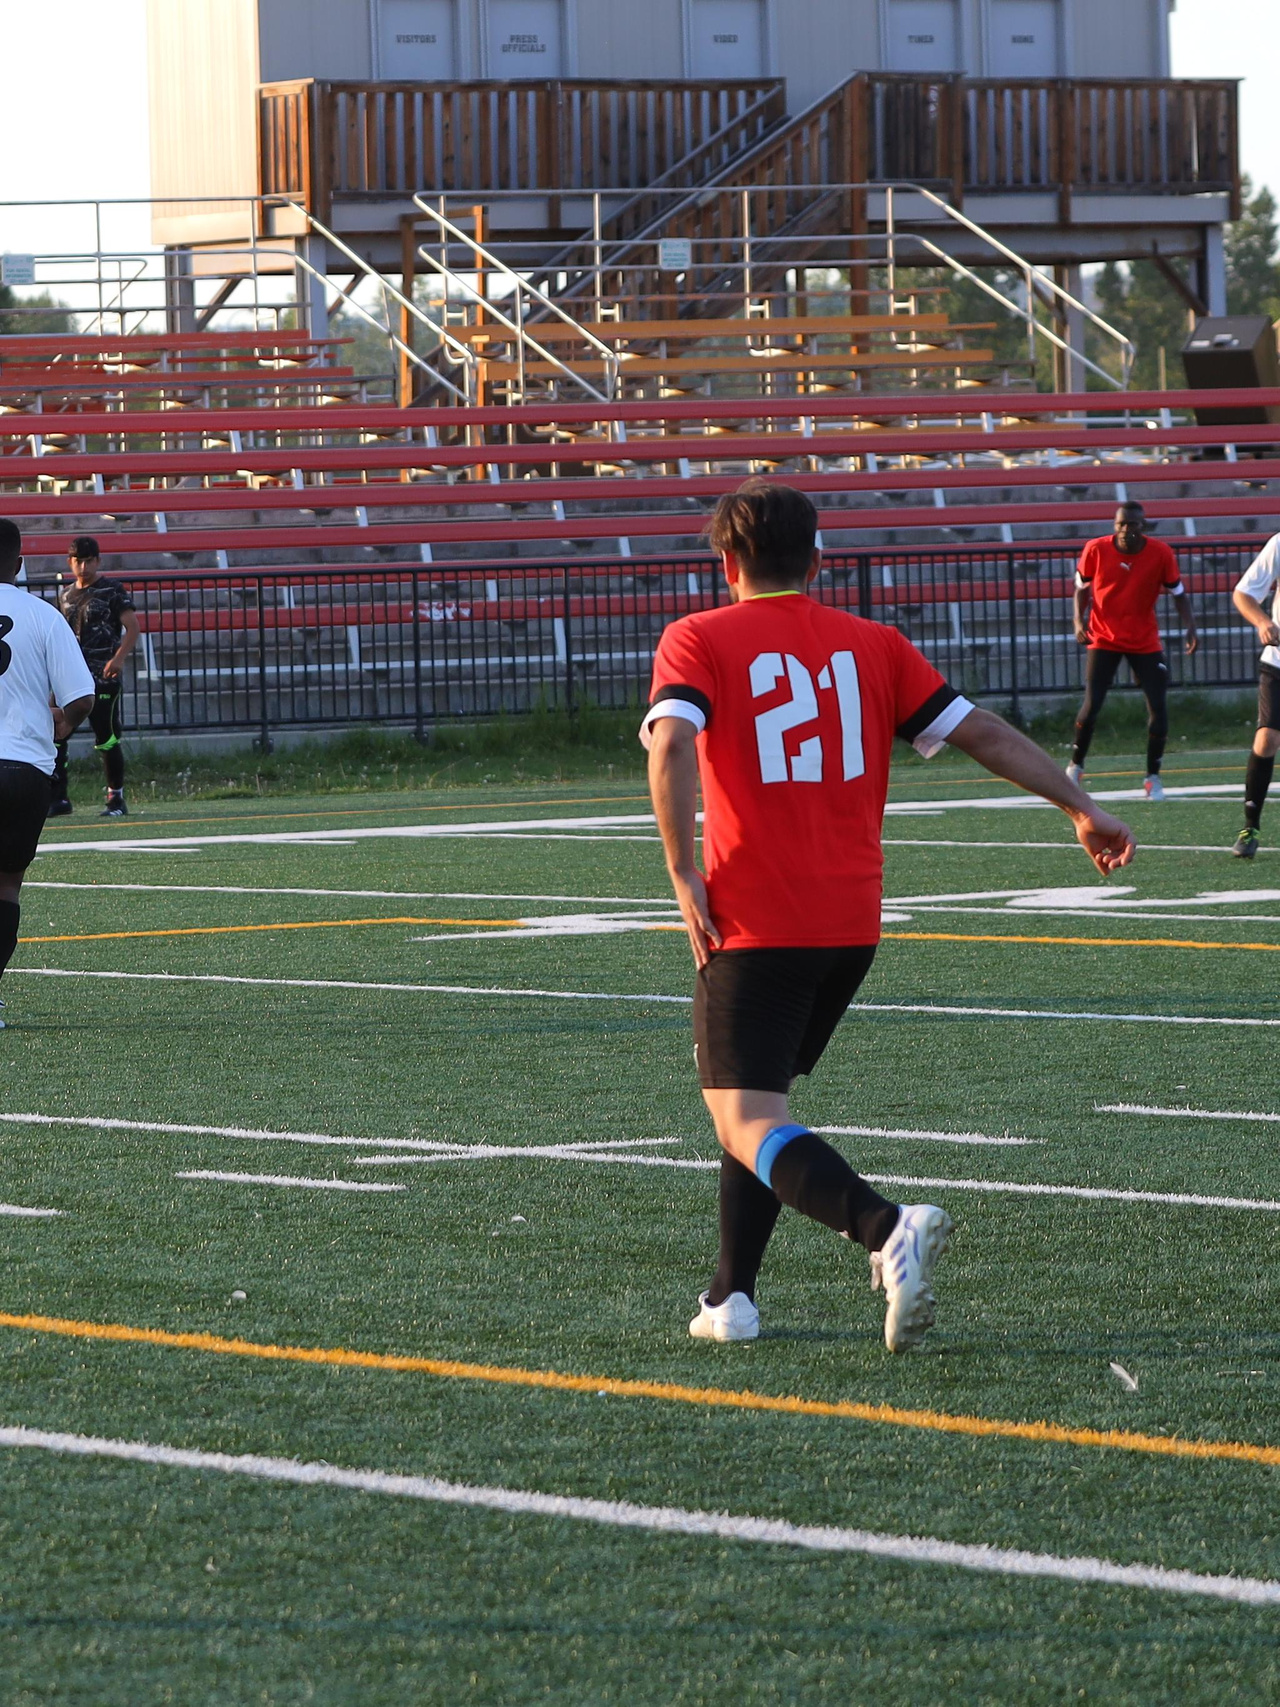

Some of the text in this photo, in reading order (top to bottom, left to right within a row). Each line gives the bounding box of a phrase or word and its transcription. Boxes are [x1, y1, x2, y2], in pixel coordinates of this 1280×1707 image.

[396, 34, 437, 43] VISITORS
[510, 34, 538, 43] PRESS
[502, 43, 546, 52] OFFICIALS
[748, 650, 866, 784] 21
